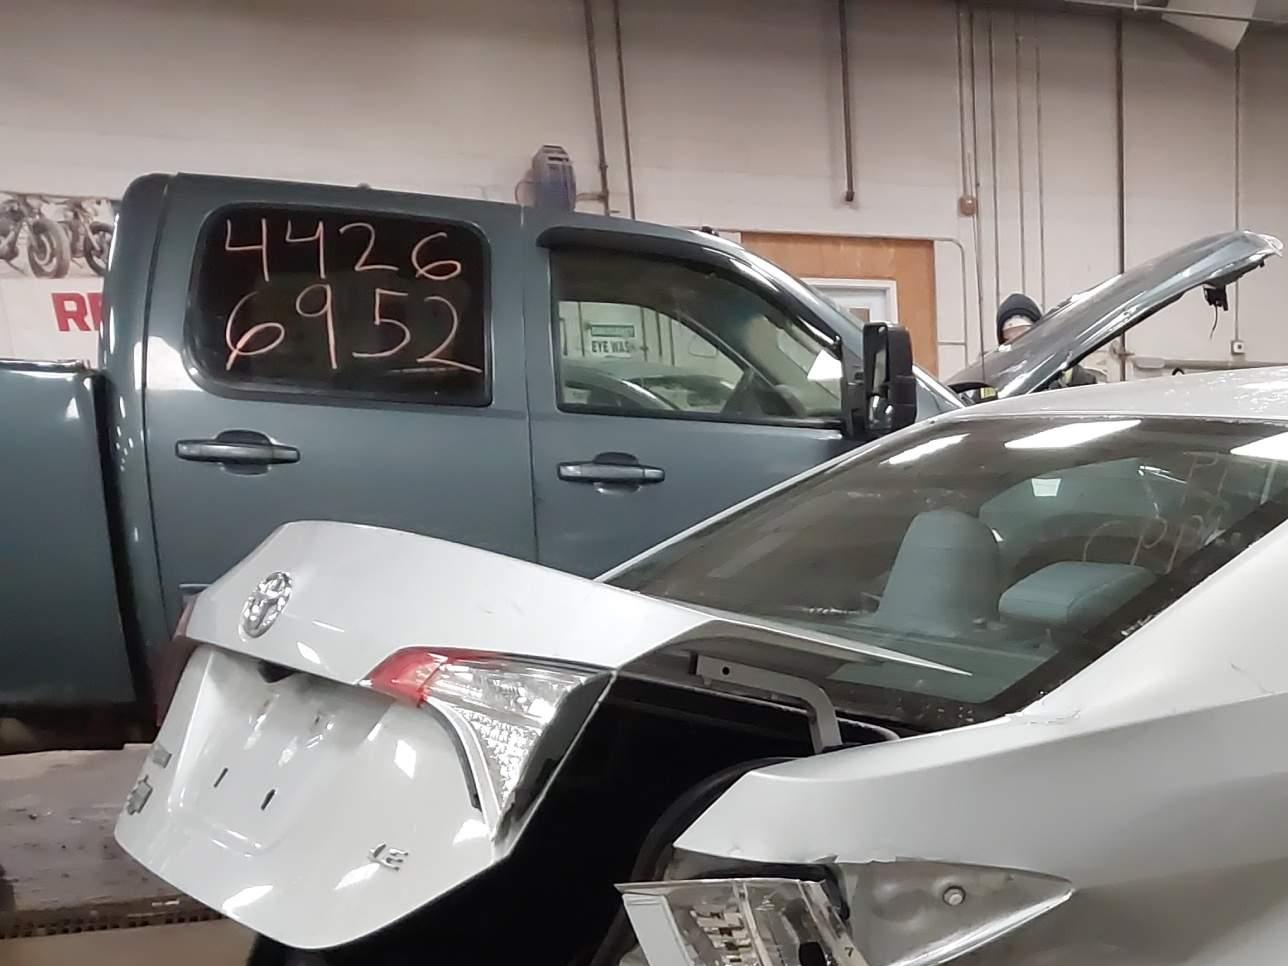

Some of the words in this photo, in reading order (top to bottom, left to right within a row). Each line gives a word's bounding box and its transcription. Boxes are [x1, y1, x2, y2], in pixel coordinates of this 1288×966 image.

[224, 217, 463, 282] 4426
[224, 284, 483, 374] 6952
[591, 340, 609, 353] EYE
